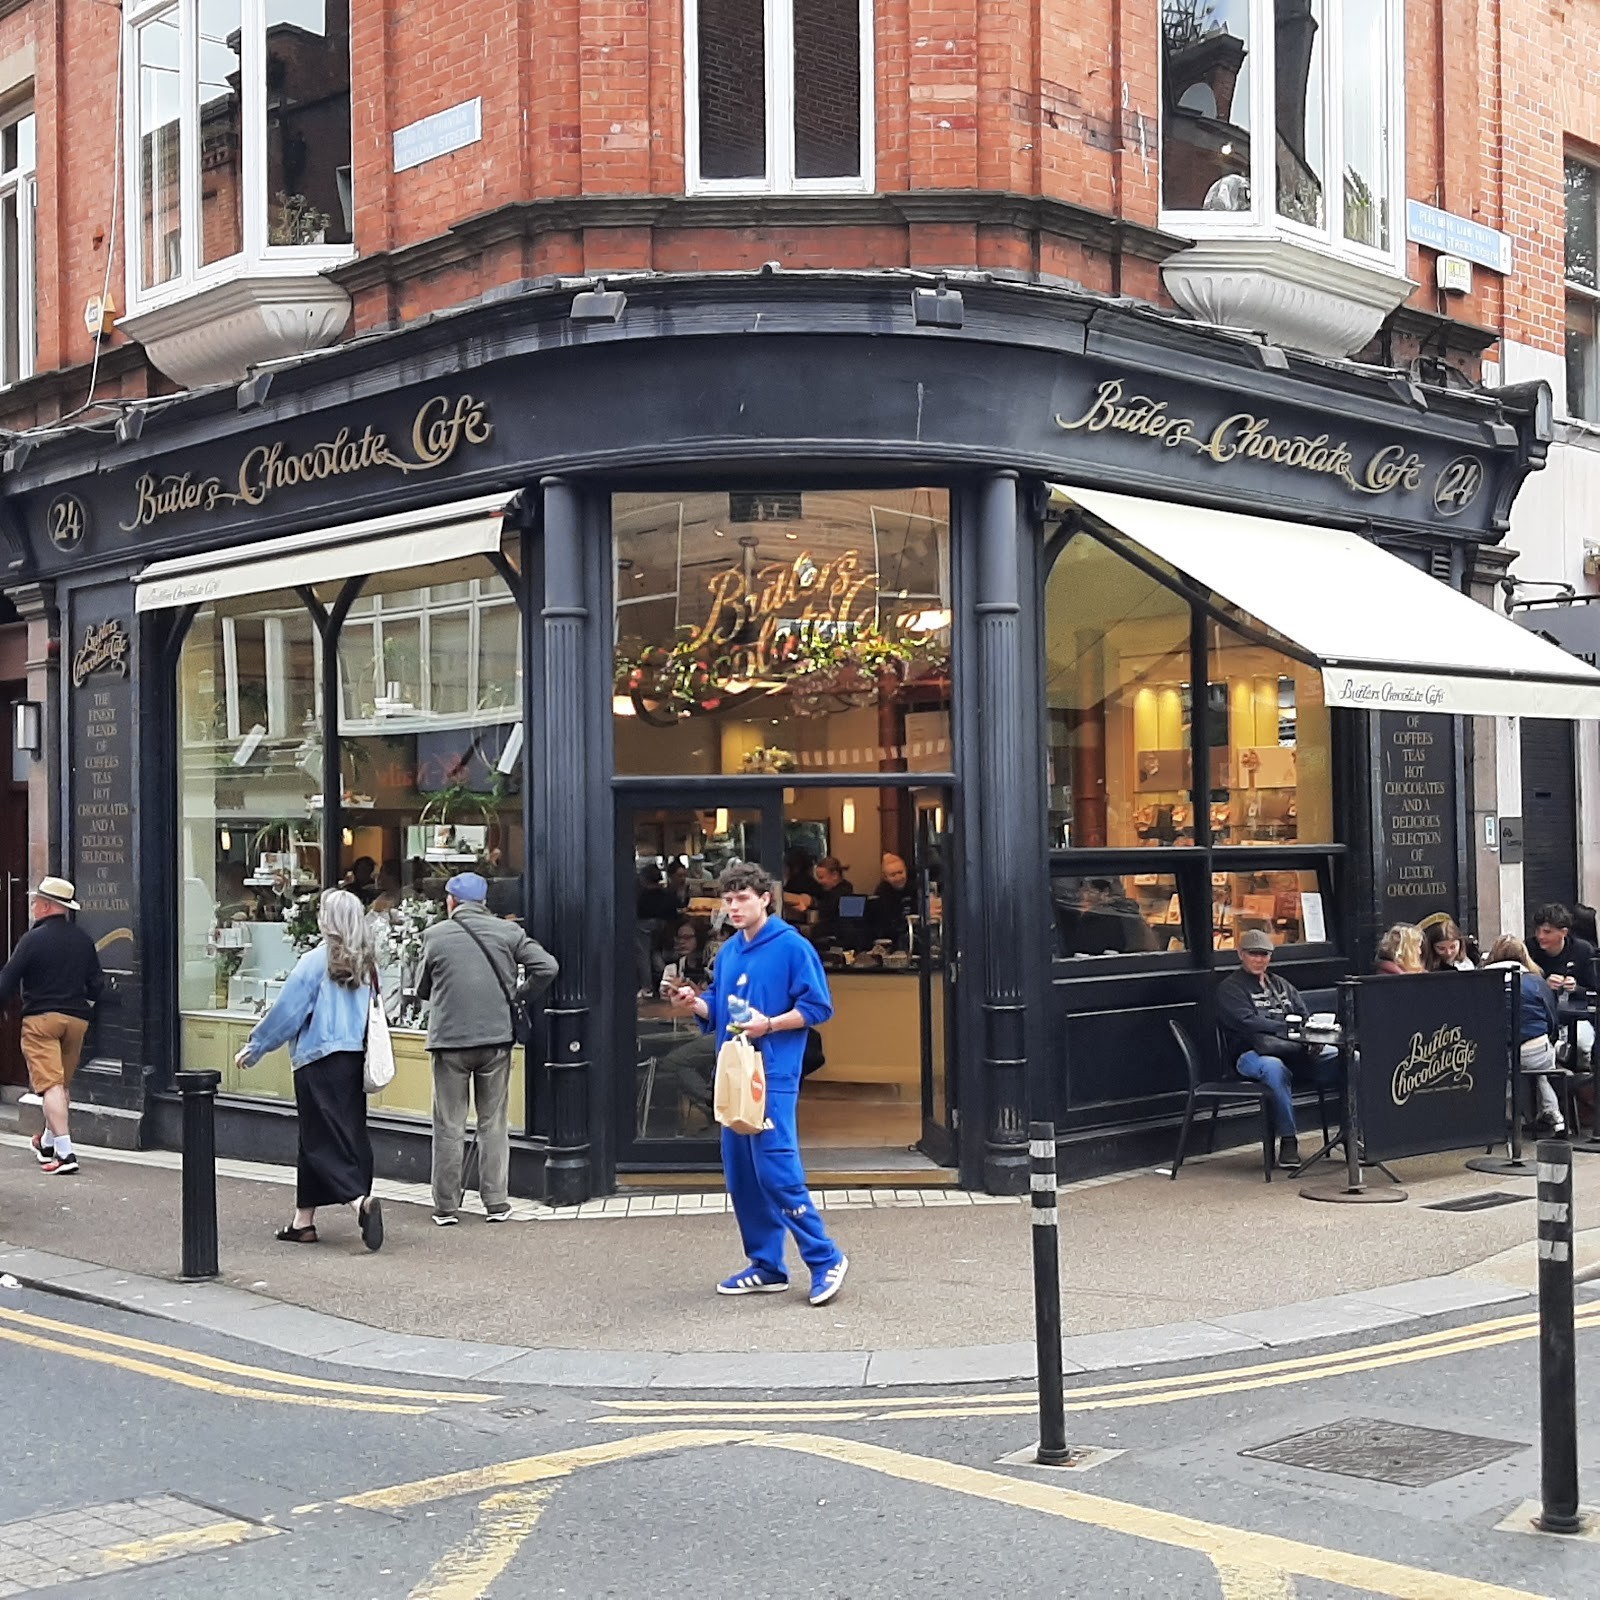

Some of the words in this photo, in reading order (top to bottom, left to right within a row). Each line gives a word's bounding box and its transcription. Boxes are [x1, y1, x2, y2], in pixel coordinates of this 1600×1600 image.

[438, 125, 472, 147] STREET
[1410, 224, 1442, 243] WILLIAM
[1446, 236, 1473, 254] STREET
[1055, 378, 1197, 447] Butlers
[1209, 413, 1355, 477] Chocolate
[1364, 444, 1426, 494] Café
[118, 472, 226, 532] Butlers
[237, 424, 392, 506] Chocolate
[411, 394, 495, 465] Café
[1437, 462, 1478, 504] 24
[53, 503, 81, 541] 24
[1338, 679, 1380, 703] Butlers
[94, 693, 110, 706] THE
[88, 708, 116, 721] FINEST
[1406, 715, 1420, 728] OF
[86, 723, 118, 737] BLENDS
[1393, 731, 1433, 745] COFFEES
[96, 740, 107, 752] OF
[1402, 749, 1425, 762] TEAS
[93, 771, 112, 784] TEAS
[1404, 765, 1424, 778] HOT
[93, 788, 110, 800] HOT
[1385, 782, 1445, 795] CHOCOLATES
[78, 803, 128, 816] CHOCOLATES
[1402, 799, 1422, 811] AND
[1424, 799, 1430, 811] A
[91, 820, 108, 832] AND
[109, 820, 115, 832] A
[1392, 815, 1440, 829] DELICIOUS
[82, 835, 124, 847] DELICIOUS
[1391, 832, 1441, 845] SELECTION
[81, 850, 124, 864] SELECTION
[1411, 849, 1424, 861] OF
[1399, 866, 1434, 879] LUXURY
[1387, 882, 1446, 896] CHOCOLATES
[1404, 1023, 1462, 1071] Butlers
[1391, 1053, 1454, 1106] Chocolate
[1451, 1040, 1477, 1081] Café
